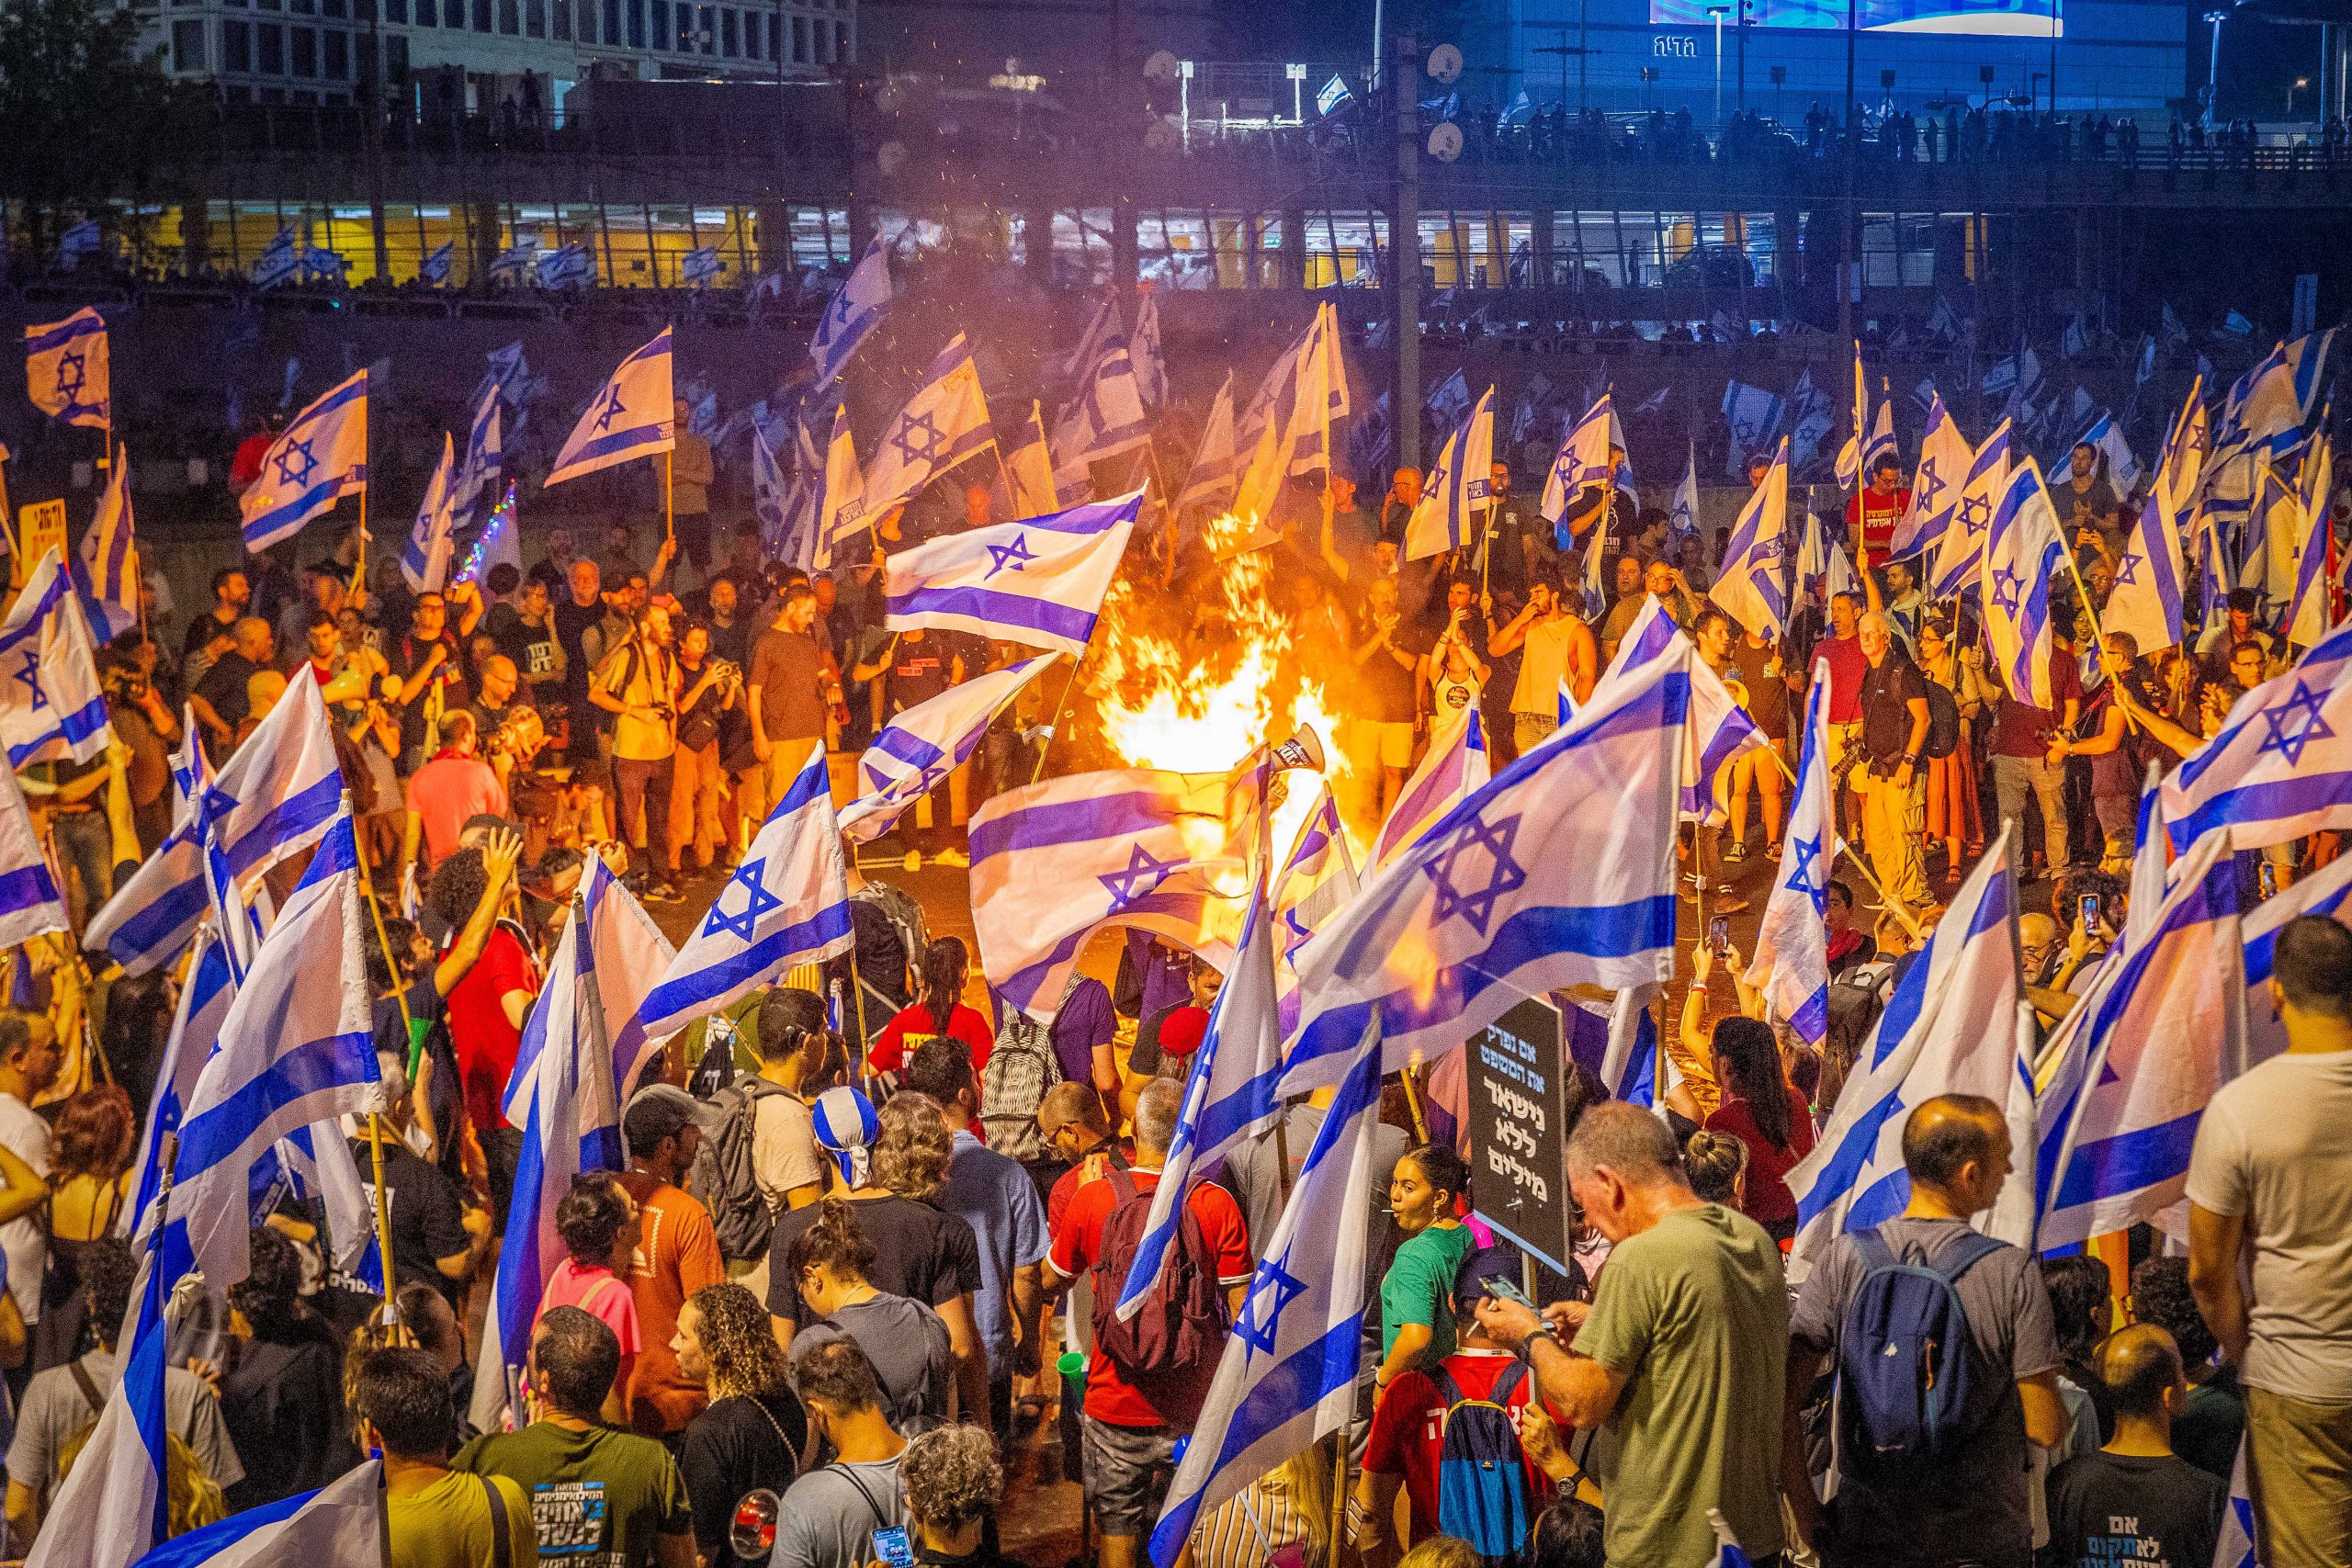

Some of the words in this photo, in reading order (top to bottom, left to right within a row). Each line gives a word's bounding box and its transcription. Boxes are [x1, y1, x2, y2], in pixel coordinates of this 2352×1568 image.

[1487, 1023, 1518, 1055] נפרק
[1519, 1036, 1537, 1065] אם
[1527, 1071, 1545, 1095] את
[1495, 1116, 1536, 1158] ללא
[2109, 1516, 2139, 1535] אם
